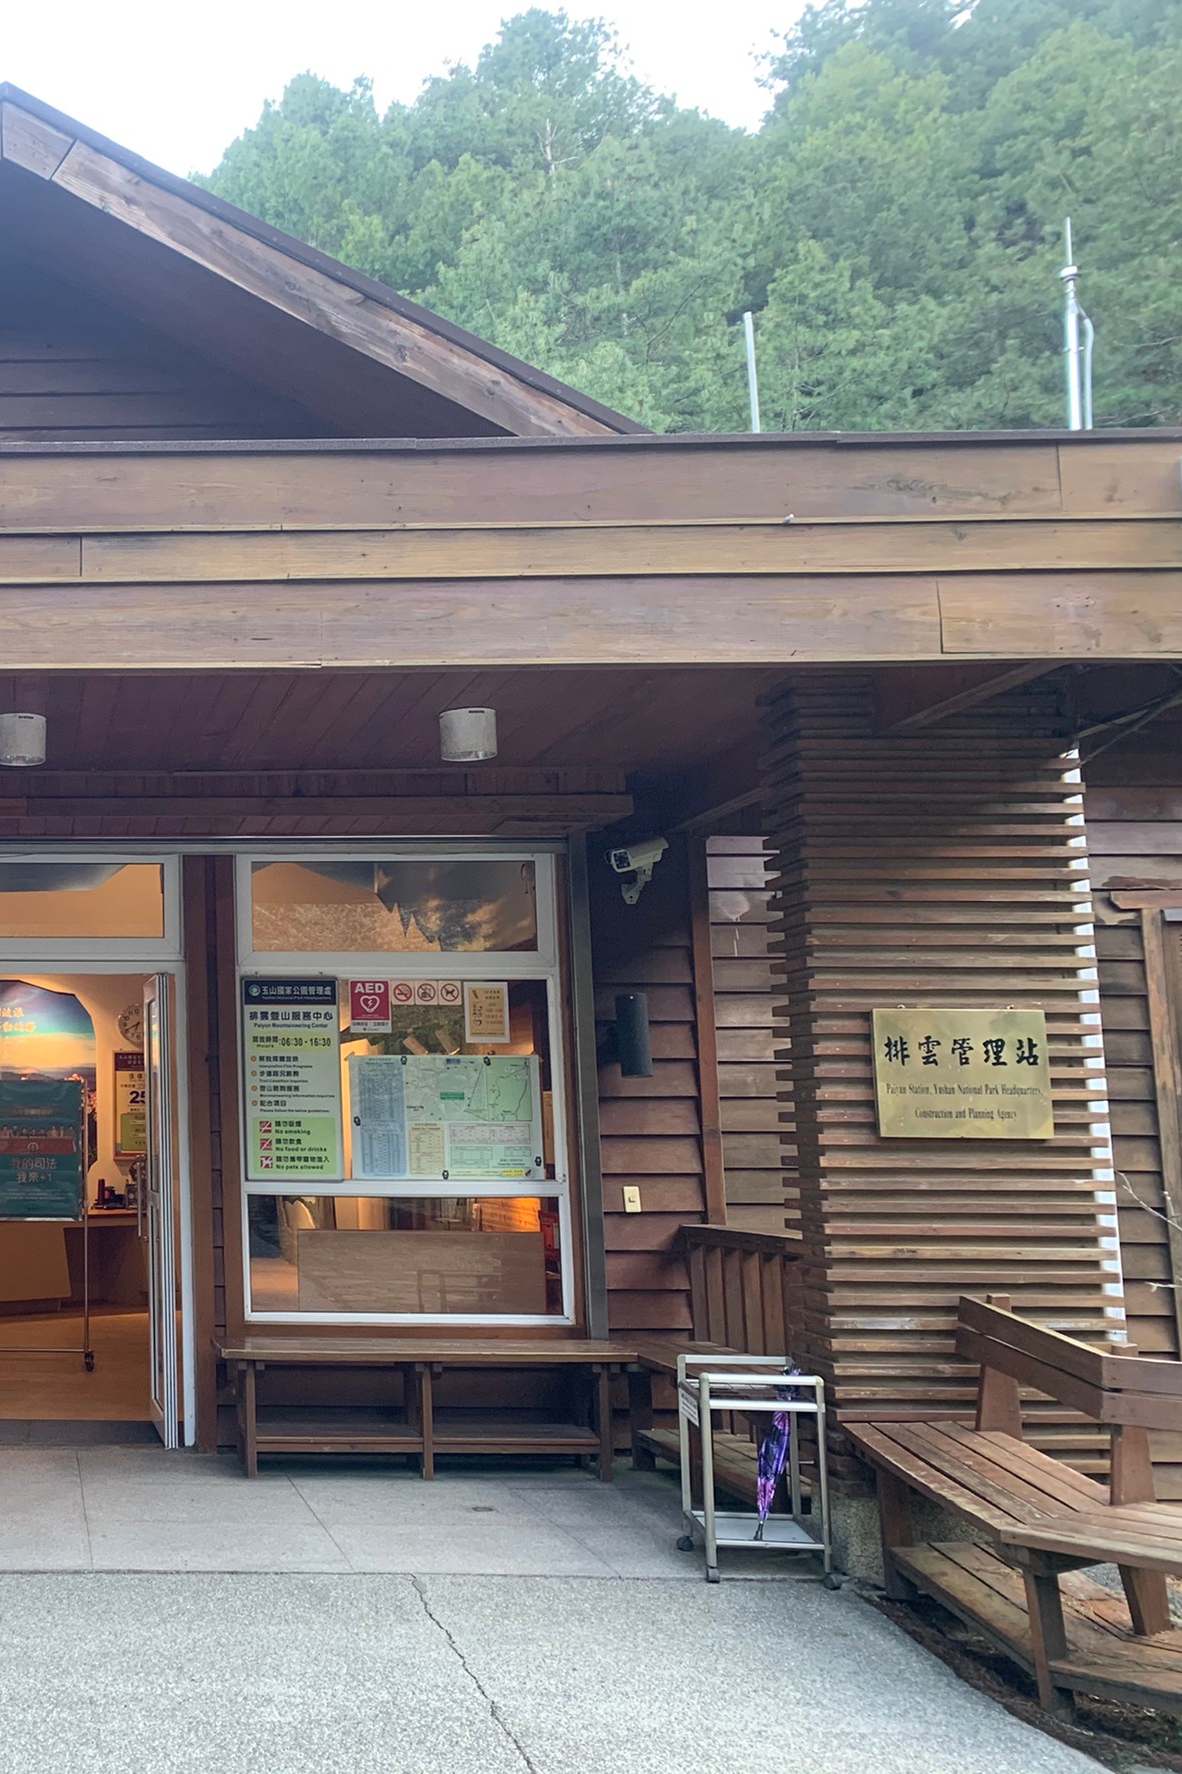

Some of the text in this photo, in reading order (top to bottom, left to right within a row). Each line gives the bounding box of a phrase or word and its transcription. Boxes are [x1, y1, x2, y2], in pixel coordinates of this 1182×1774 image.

[261, 985, 332, 996] 玉山國家公園管理處
[355, 982, 385, 994] AED
[249, 1011, 334, 1021] 排雲登山服務中心
[883, 1035, 1040, 1067] 排雲管理站
[886, 1083, 907, 1097] Paiyun
[933, 1083, 956, 1095] Yushan
[957, 1083, 983, 1095] National
[984, 1083, 999, 1095] Park
[914, 1106, 1017, 1121] Construction and Planning Agency
